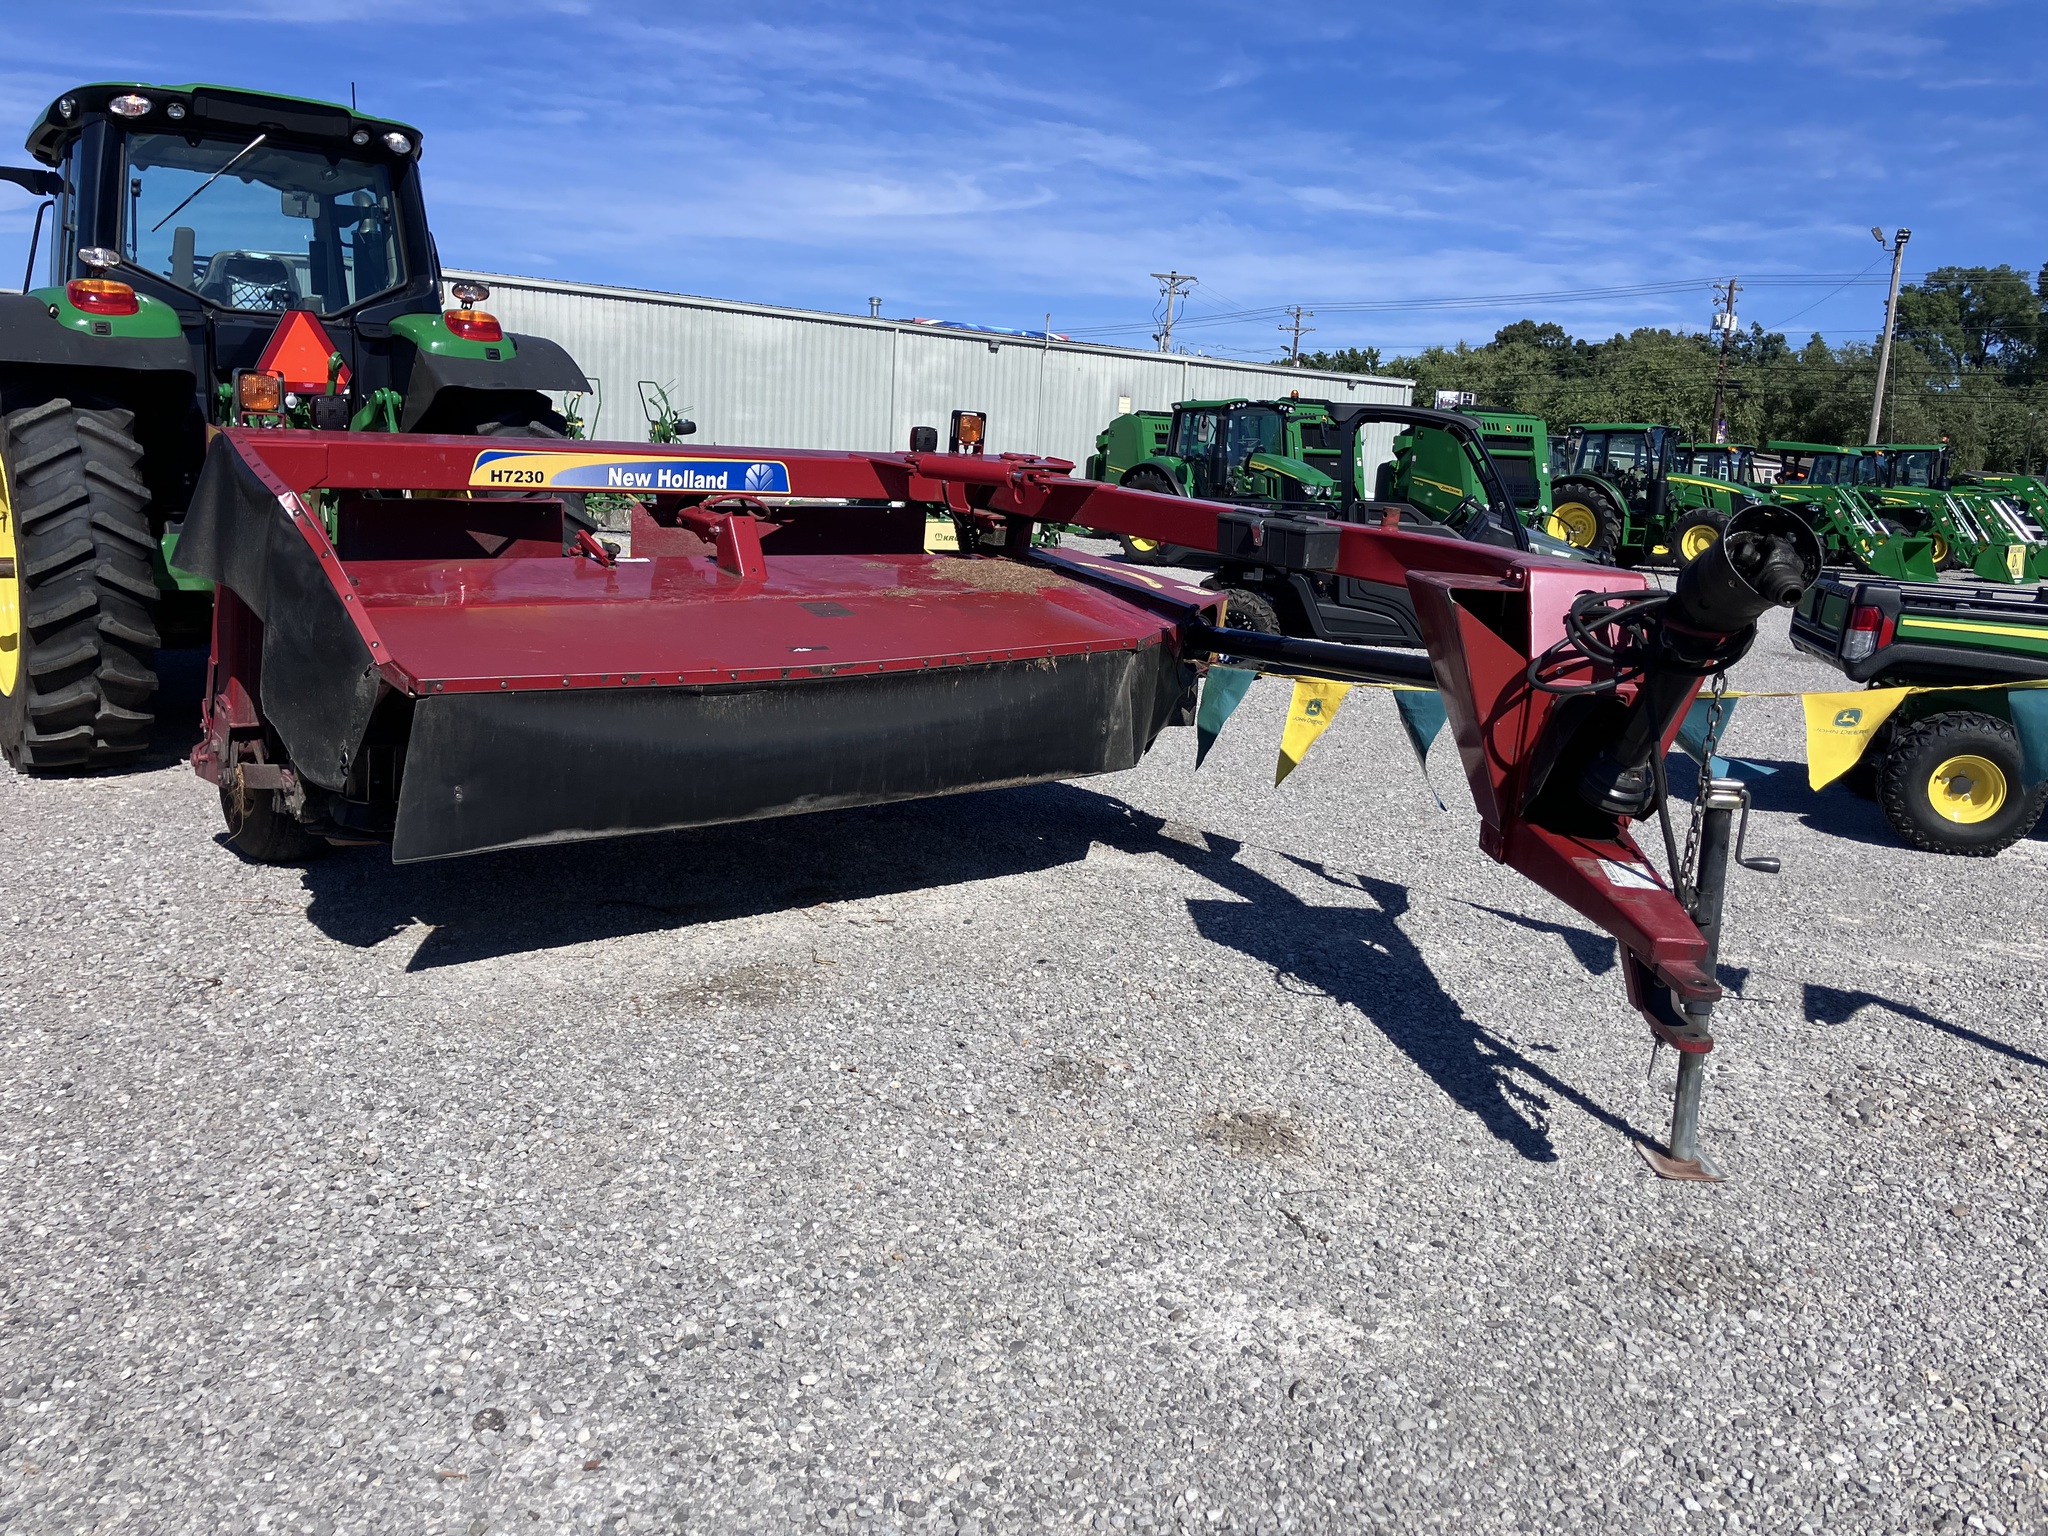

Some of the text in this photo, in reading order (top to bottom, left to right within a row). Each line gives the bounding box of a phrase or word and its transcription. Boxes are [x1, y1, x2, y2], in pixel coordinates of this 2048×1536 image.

[490, 469, 544, 484] H7230
[608, 467, 728, 489] New Holland
[1307, 717, 1324, 725] DEERE
[1814, 727, 1870, 736] JOHN DEERE
